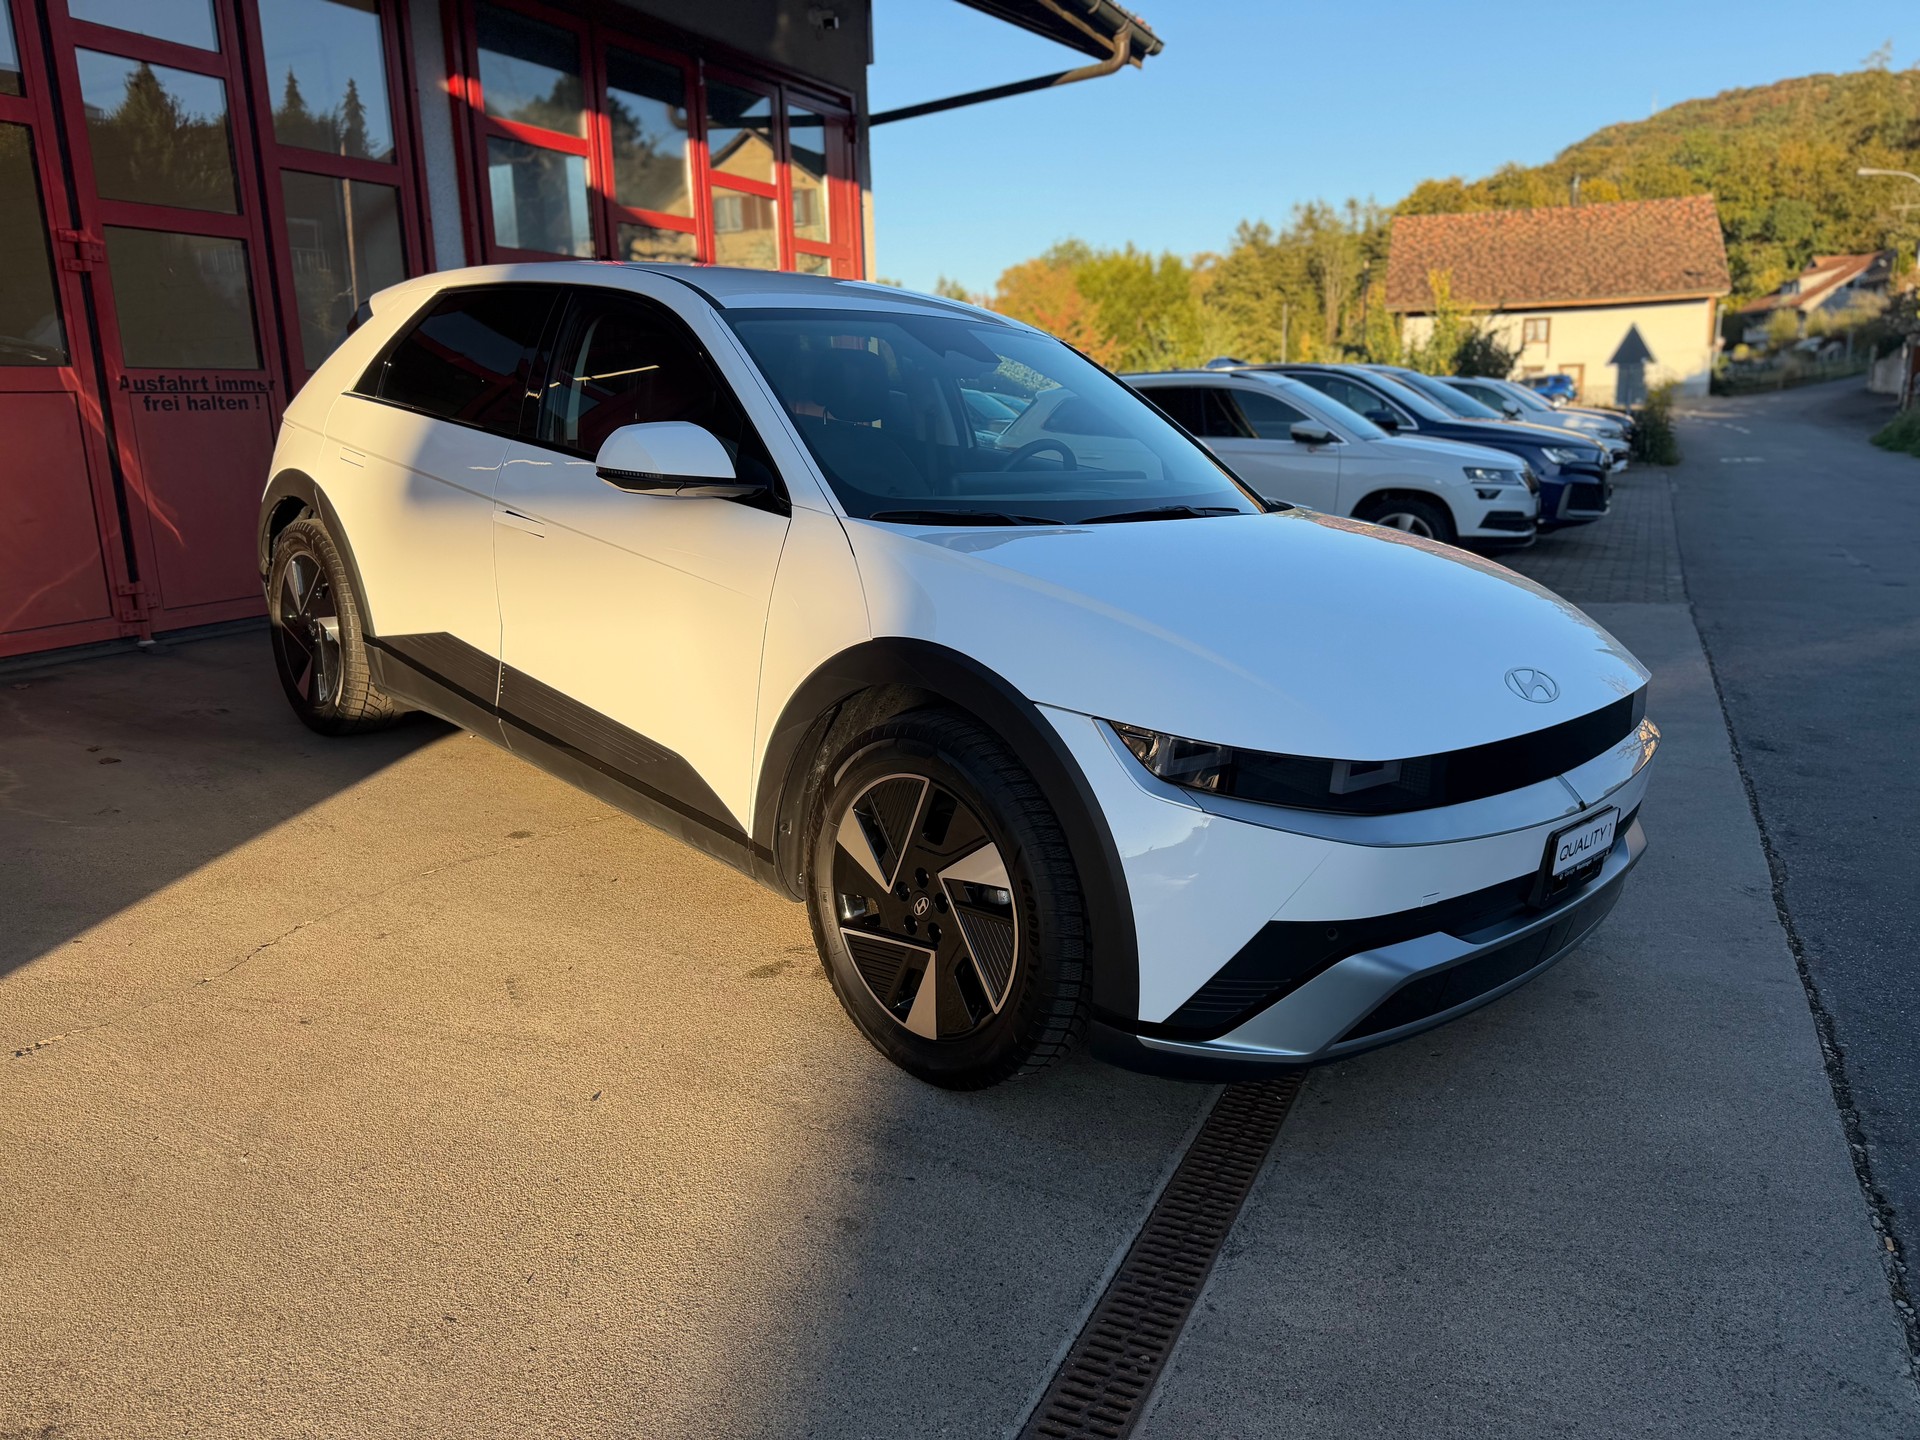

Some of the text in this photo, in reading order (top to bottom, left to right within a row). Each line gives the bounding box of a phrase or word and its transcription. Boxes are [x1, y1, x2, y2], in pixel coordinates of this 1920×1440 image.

[118, 375, 275, 392] Ausfahrt immer
[143, 395, 261, 411] frei halten !
[1559, 825, 1607, 862] QUALITY
[1608, 822, 1612, 837] 1
